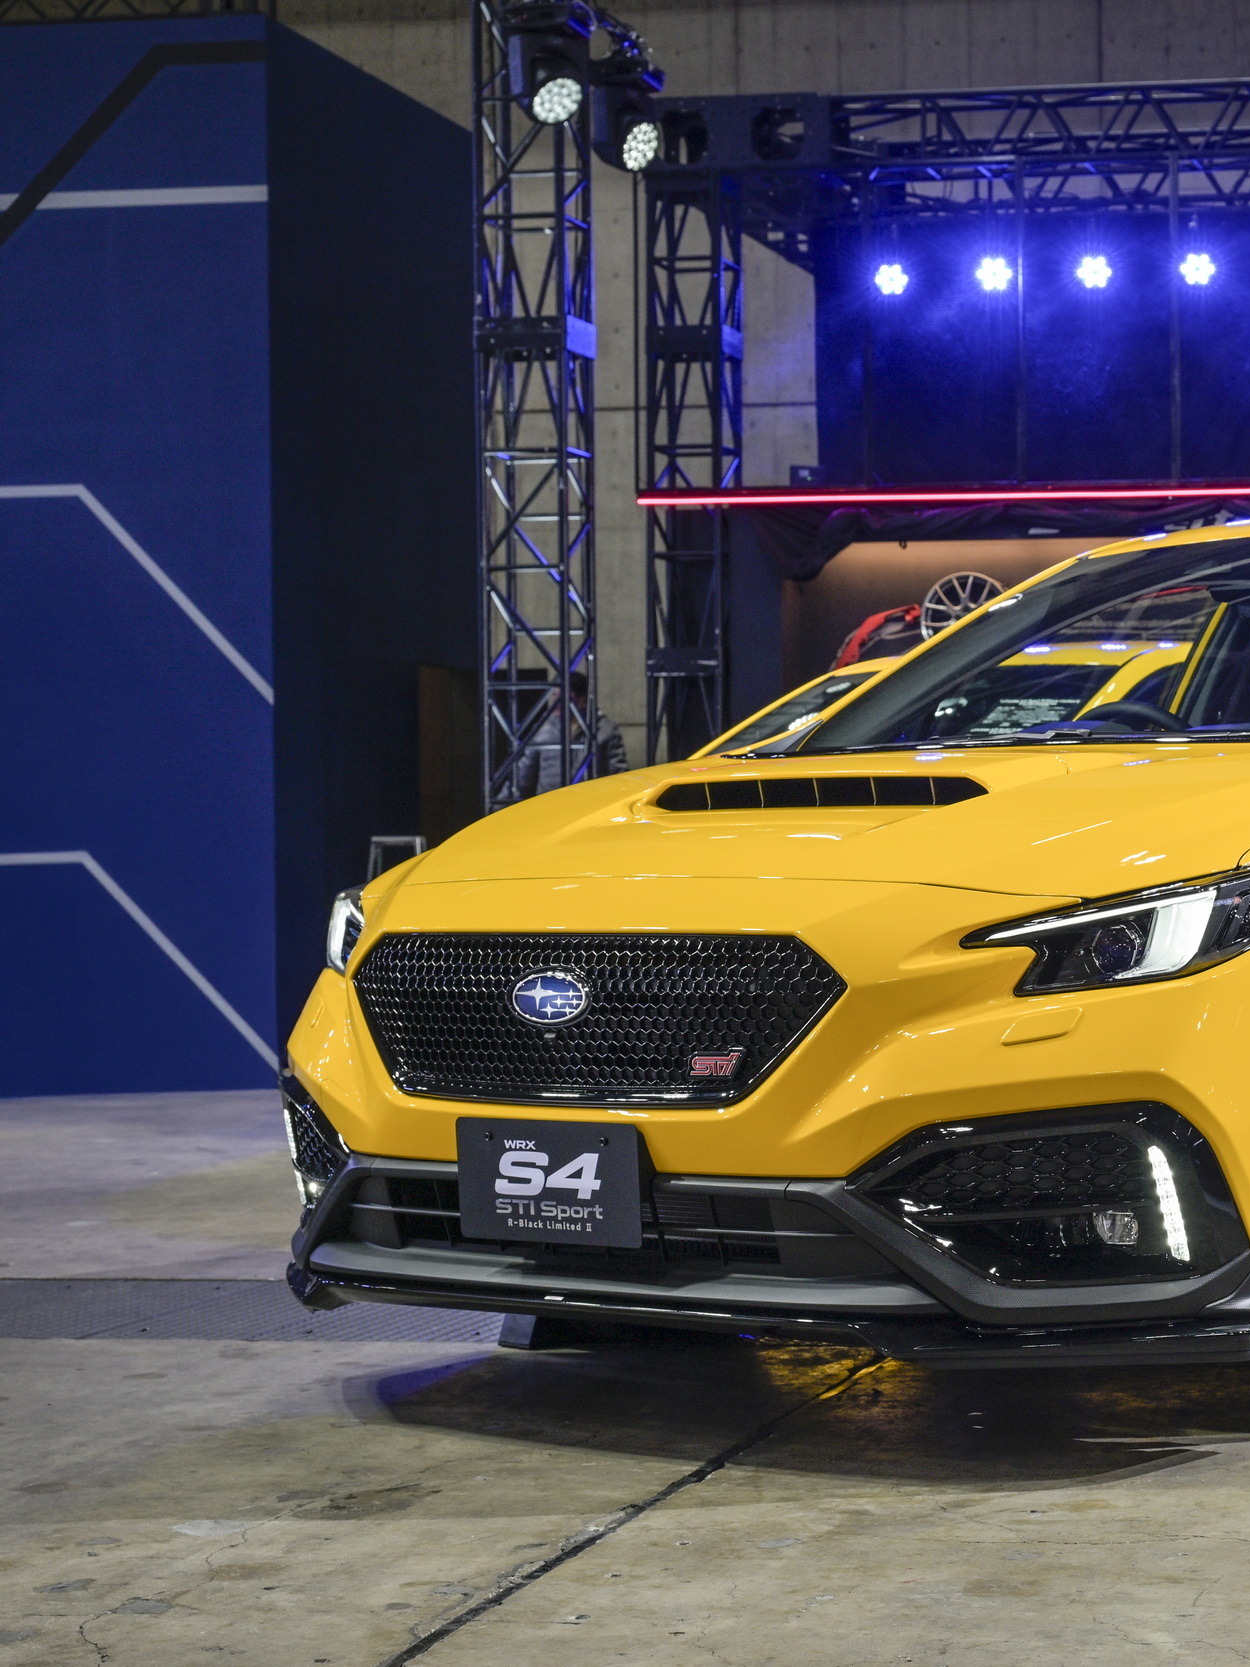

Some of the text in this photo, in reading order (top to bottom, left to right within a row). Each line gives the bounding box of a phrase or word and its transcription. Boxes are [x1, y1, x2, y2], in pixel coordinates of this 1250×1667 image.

[503, 1139, 536, 1150] WRX
[494, 1150, 602, 1200] S4
[495, 1198, 604, 1221] STI Sport
[507, 1219, 544, 1230] R-Black
[546, 1220, 582, 1232] Limited
